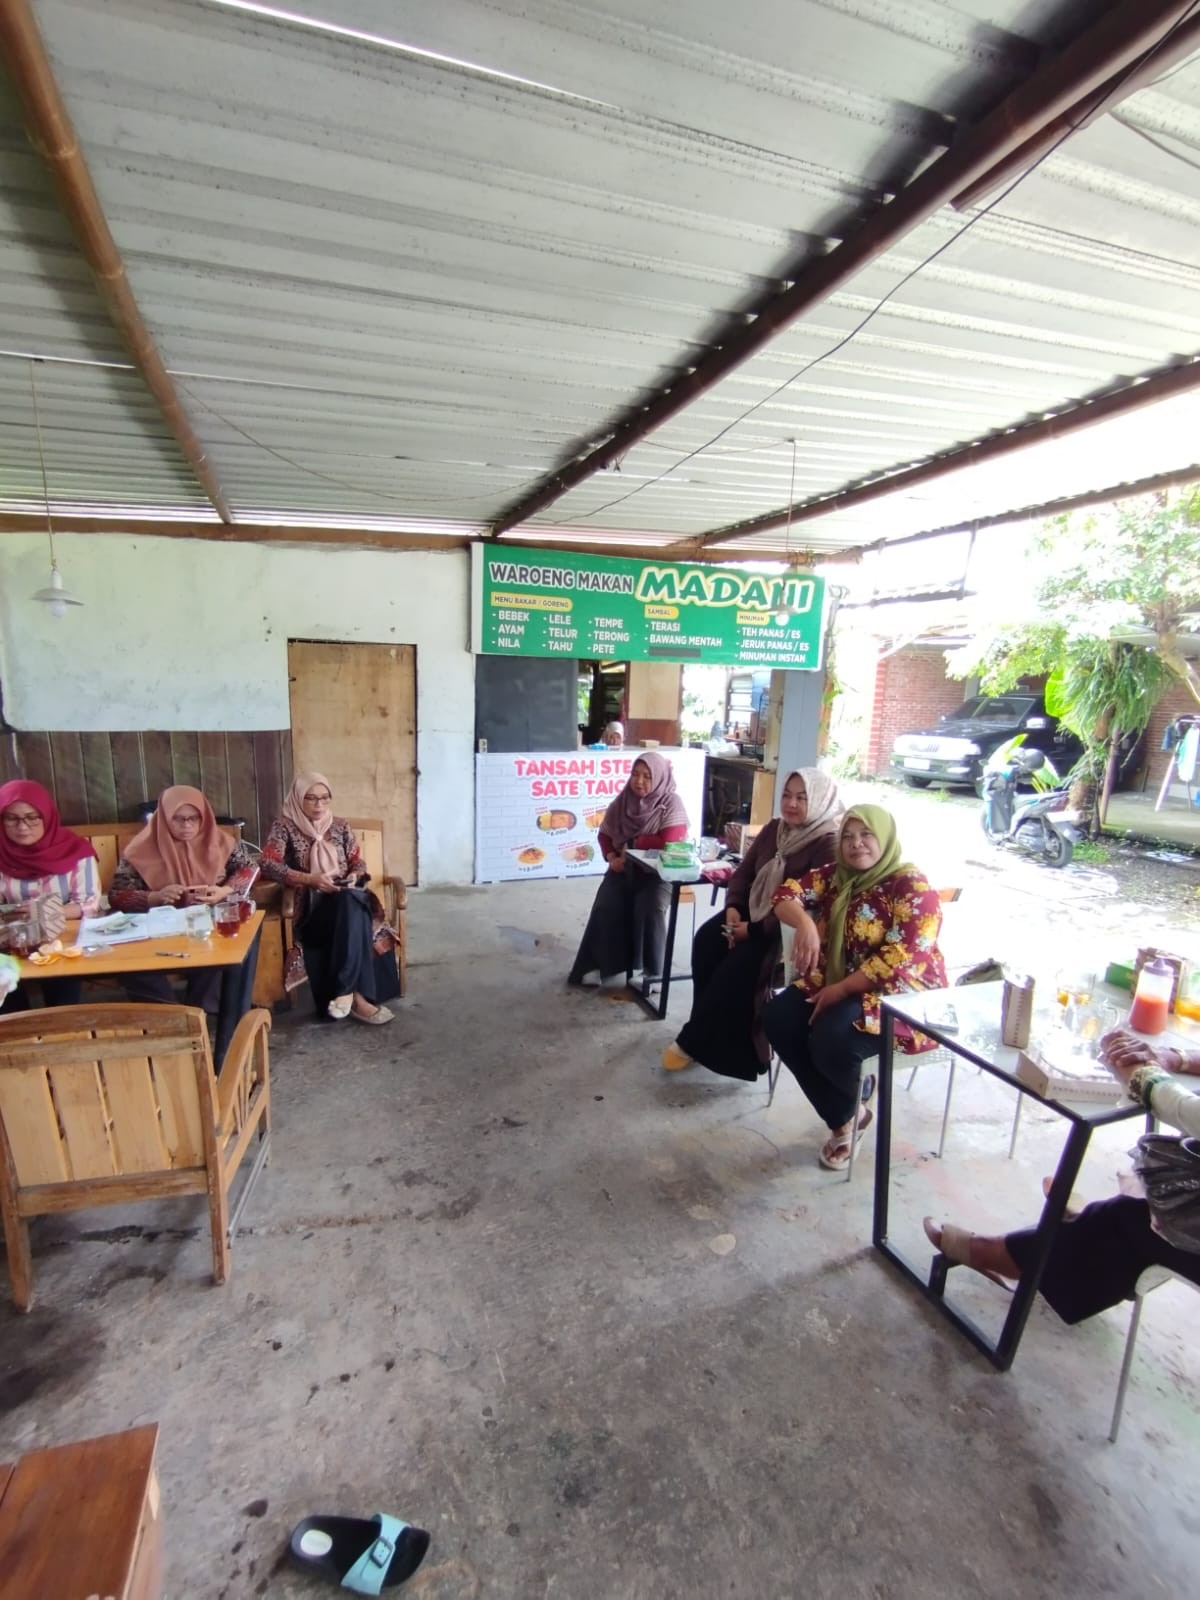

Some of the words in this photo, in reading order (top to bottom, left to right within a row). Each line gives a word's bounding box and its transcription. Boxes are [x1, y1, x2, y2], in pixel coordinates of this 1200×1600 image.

[489, 562, 574, 588] WAROENG
[577, 571, 634, 594] MAKAN
[494, 595, 513, 604] MENU
[514, 597, 537, 605] BAKAR
[542, 600, 569, 608] GORENG
[498, 610, 530, 622] BEBEK
[647, 608, 671, 616] SAMBAL
[549, 614, 572, 625] LELE
[594, 617, 624, 629] TEMPE
[498, 624, 525, 635] AYAM
[651, 621, 680, 632] TERASI
[549, 627, 578, 639] TELUR
[594, 631, 630, 642] TERONG
[742, 627, 757, 637] TEH
[758, 628, 784, 639] PANAS
[791, 630, 801, 639] ES
[498, 638, 521, 649] NILA
[548, 641, 573, 652] TAHU
[649, 634, 687, 645] BAWANG
[688, 636, 723, 647] MENTAH
[740, 640, 766, 649] JERUK
[767, 642, 793, 651] PANAS
[799, 642, 810, 652] ES
[592, 644, 615, 654] PETE
[739, 651, 777, 662] MINUMAN
[778, 653, 806, 663] INSTAN
[514, 759, 595, 776] TANSAH
[600, 759, 632, 775] STE
[531, 780, 579, 797] SATE
[585, 780, 626, 796] TAIC
